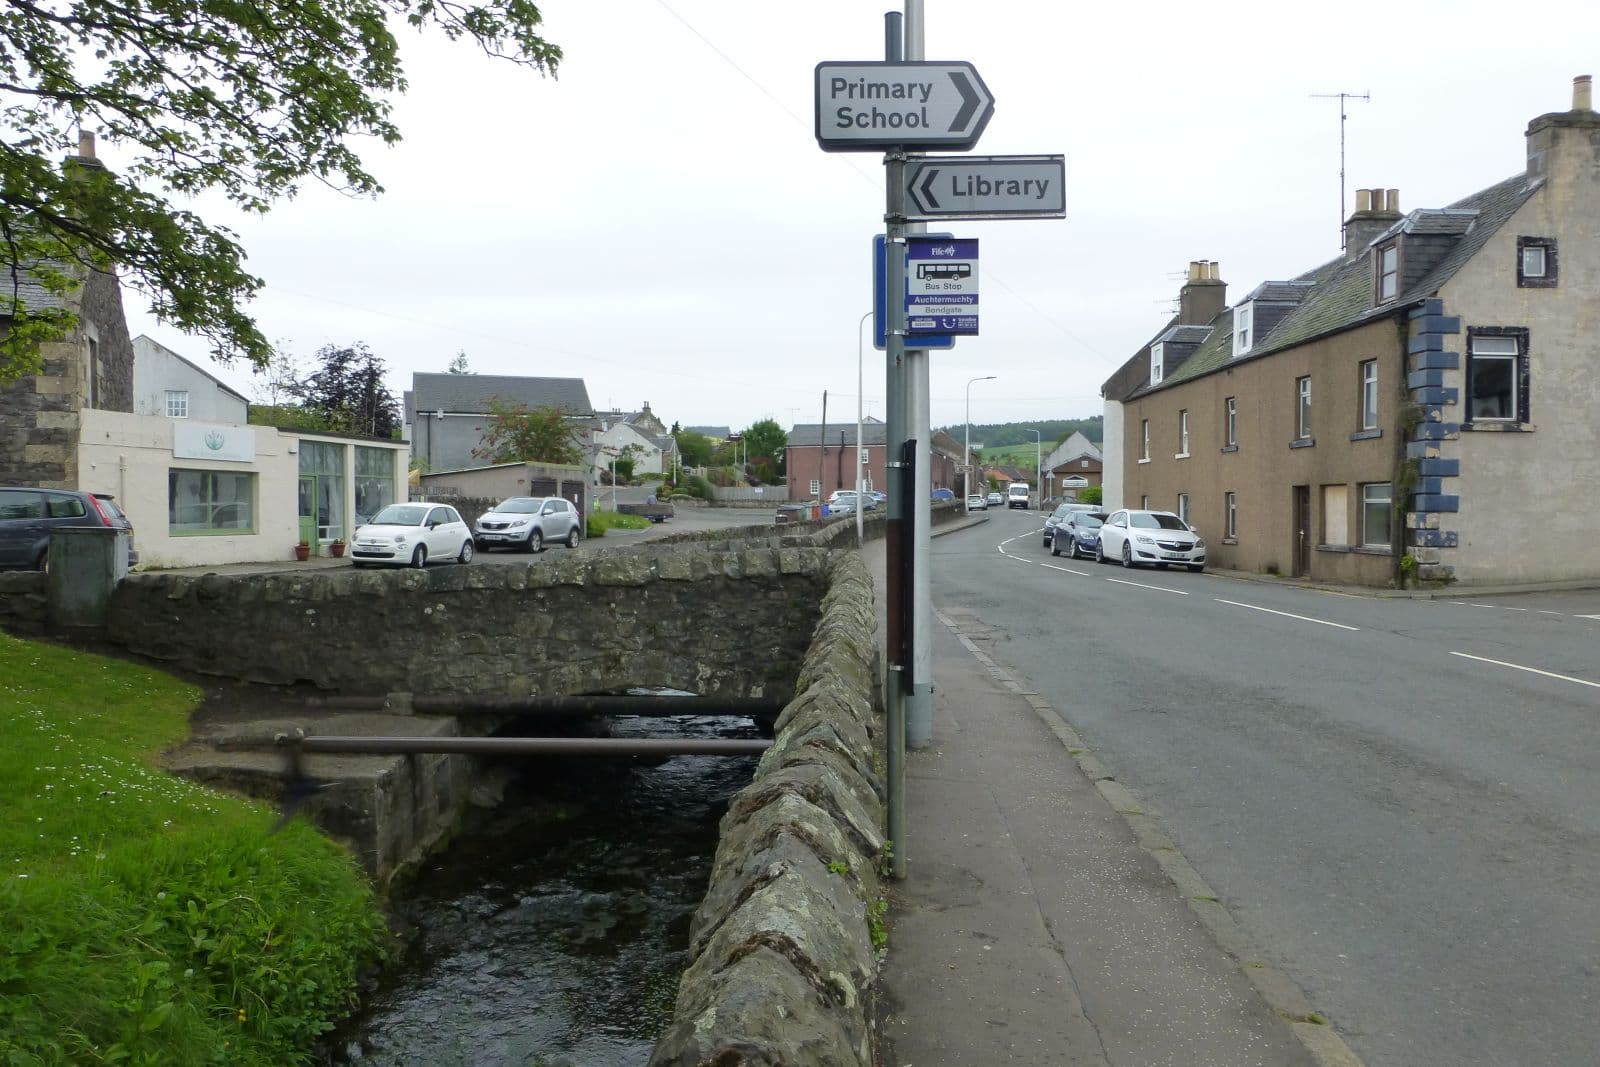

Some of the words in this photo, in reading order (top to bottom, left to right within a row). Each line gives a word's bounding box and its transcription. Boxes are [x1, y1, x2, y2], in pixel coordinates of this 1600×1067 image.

[831, 78, 933, 103] Primary
[836, 107, 930, 129] School
[952, 176, 1050, 199] Library
[943, 283, 962, 291] Stop
[914, 296, 974, 304] Auchtermuchty
[925, 306, 962, 315] Bondgate
